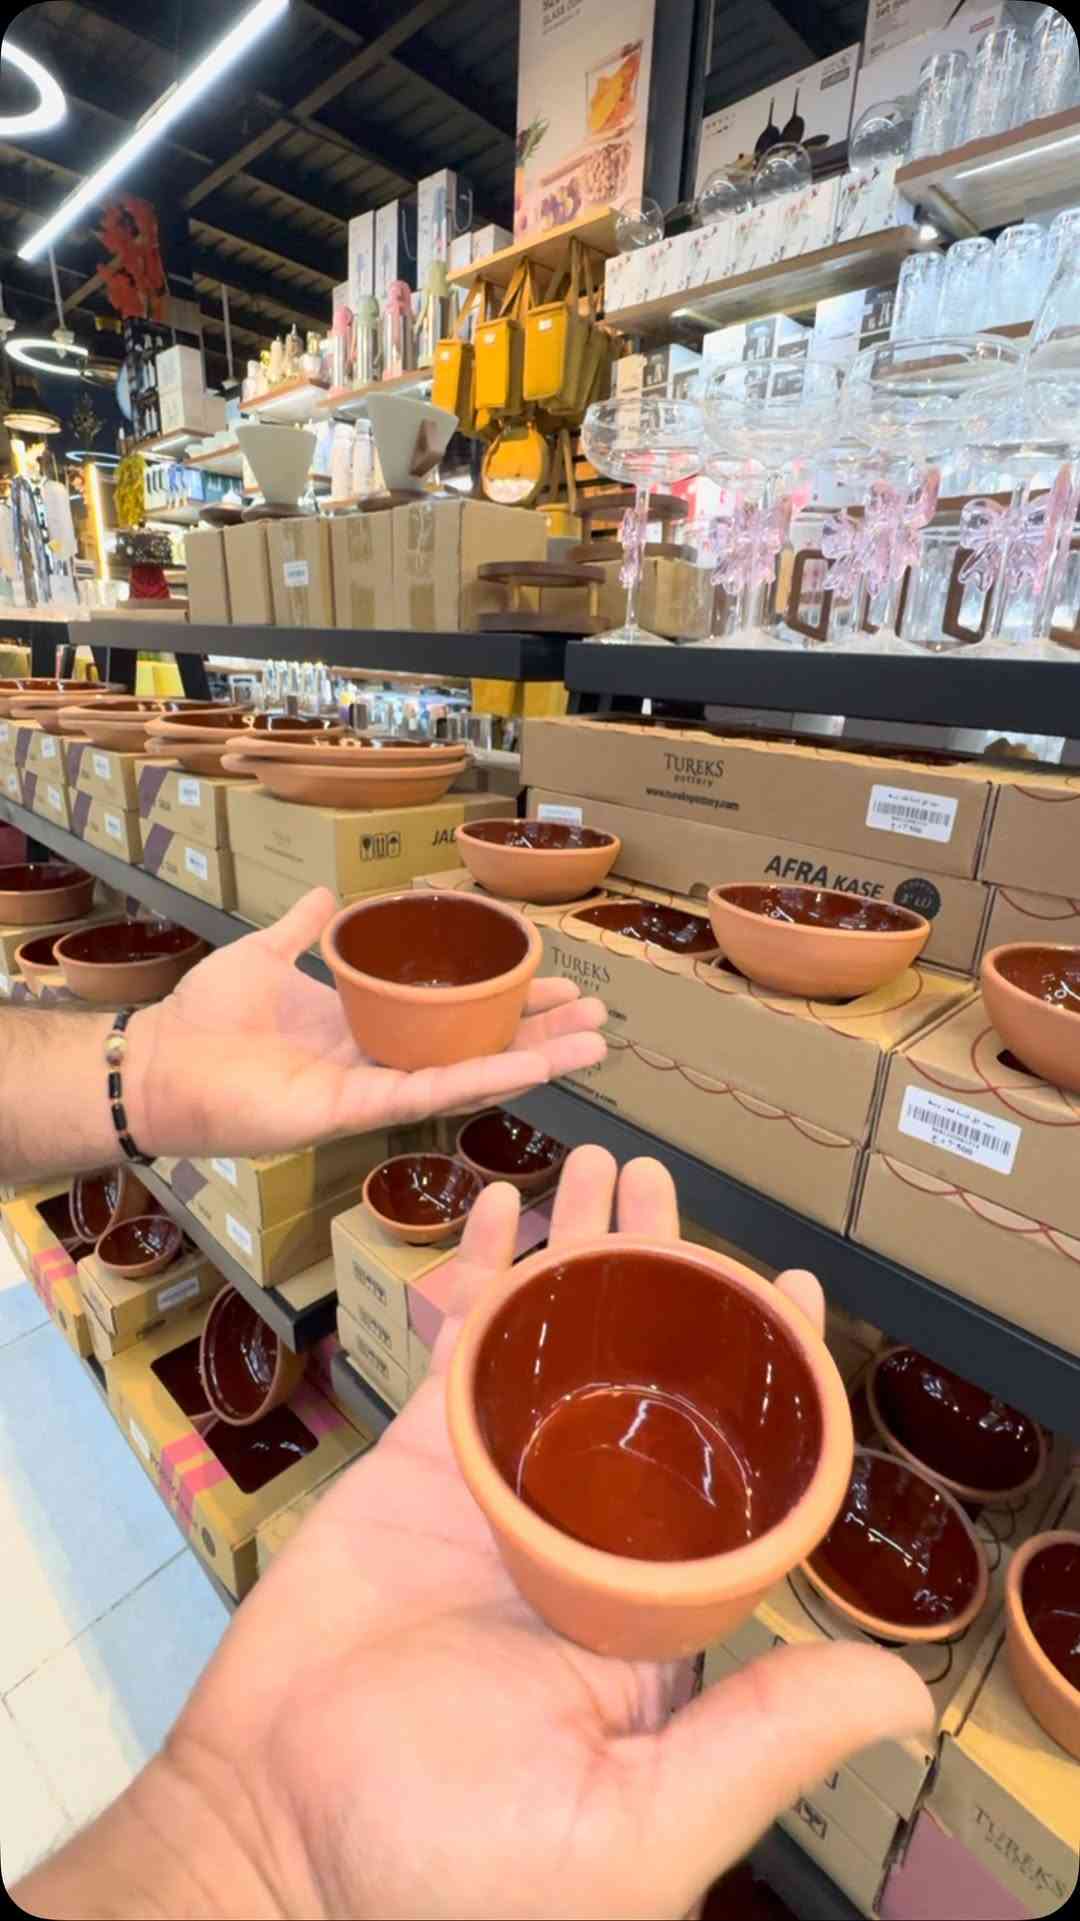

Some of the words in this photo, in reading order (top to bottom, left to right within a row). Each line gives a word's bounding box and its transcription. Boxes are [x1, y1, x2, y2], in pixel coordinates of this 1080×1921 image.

[664, 752, 725, 777] TUREKS
[764, 855, 829, 888] AFRA
[832, 875, 884, 899] KASE
[552, 946, 611, 984] TUREKS
